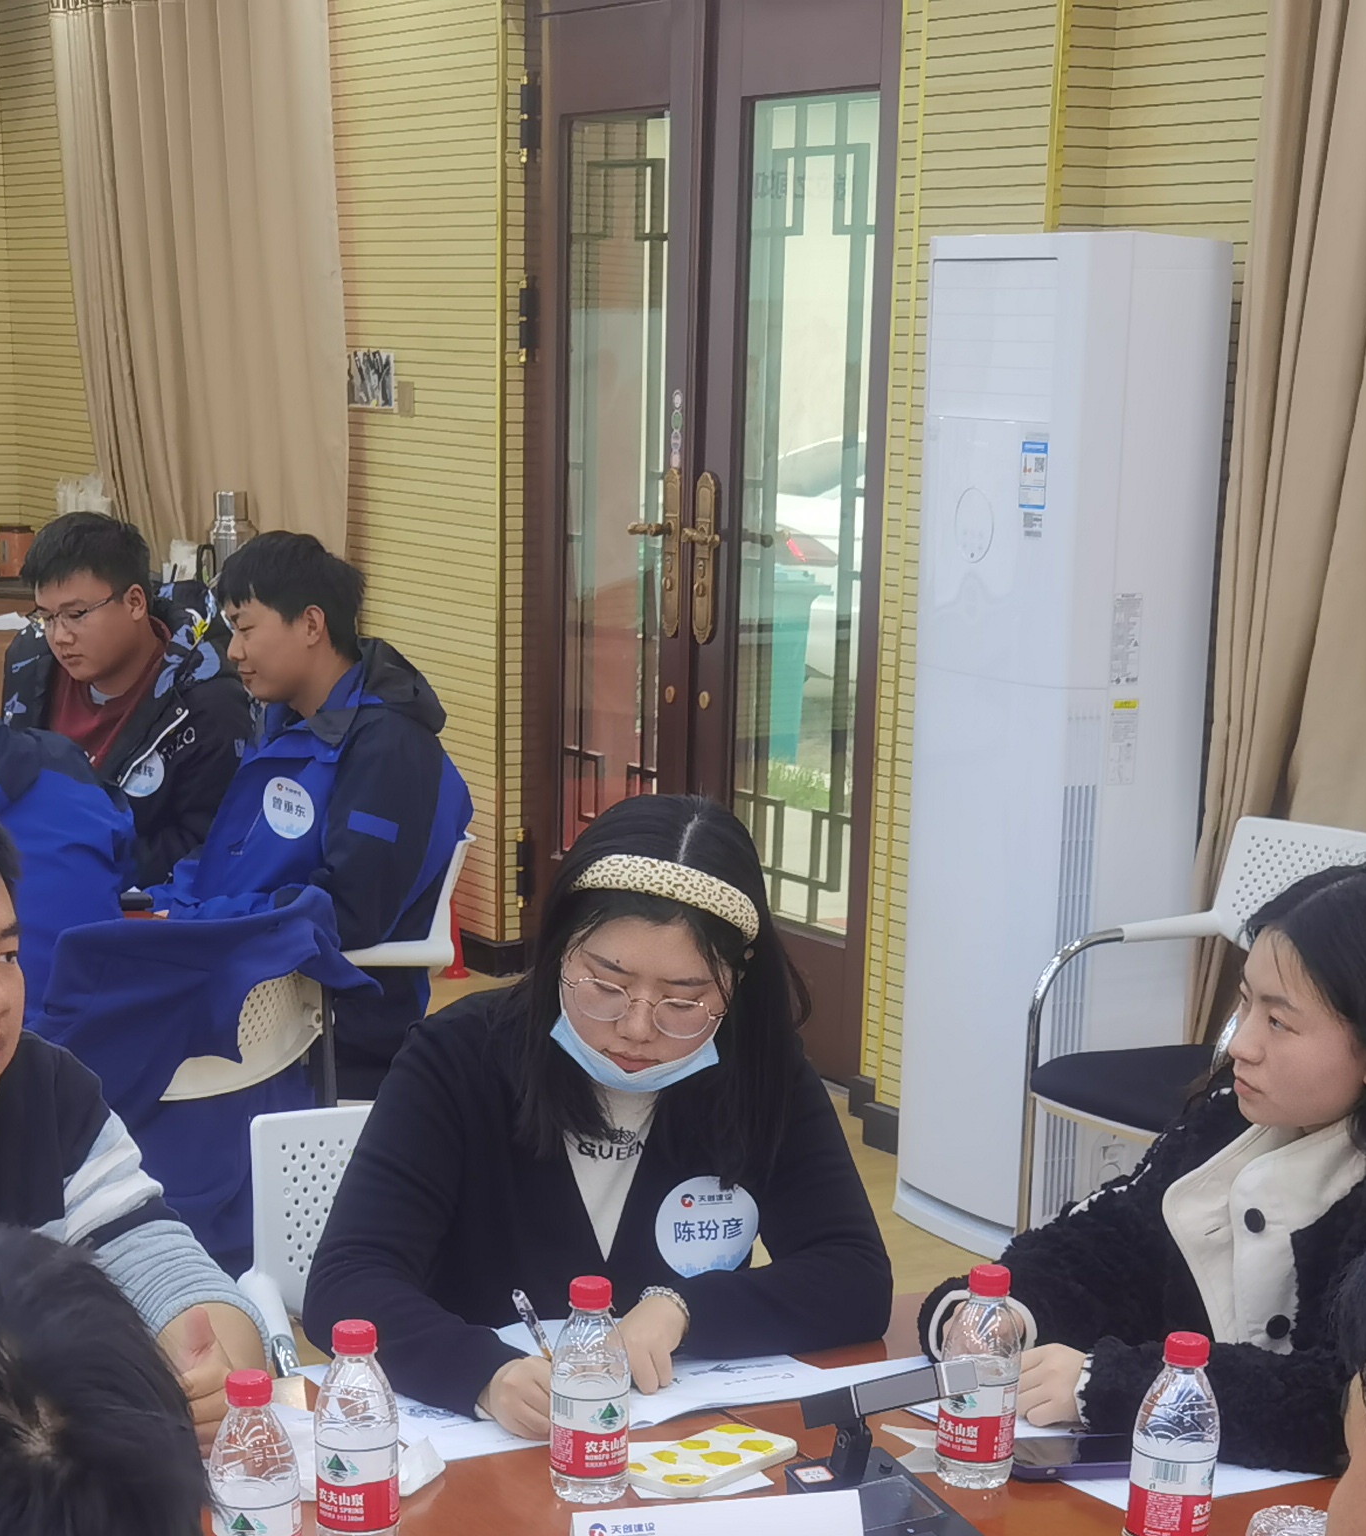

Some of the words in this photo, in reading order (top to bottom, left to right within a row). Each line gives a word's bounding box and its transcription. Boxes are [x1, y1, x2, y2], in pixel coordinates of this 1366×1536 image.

[672, 1217, 744, 1243] 陈玢彦
[319, 1487, 365, 1507] 农夫山泉
